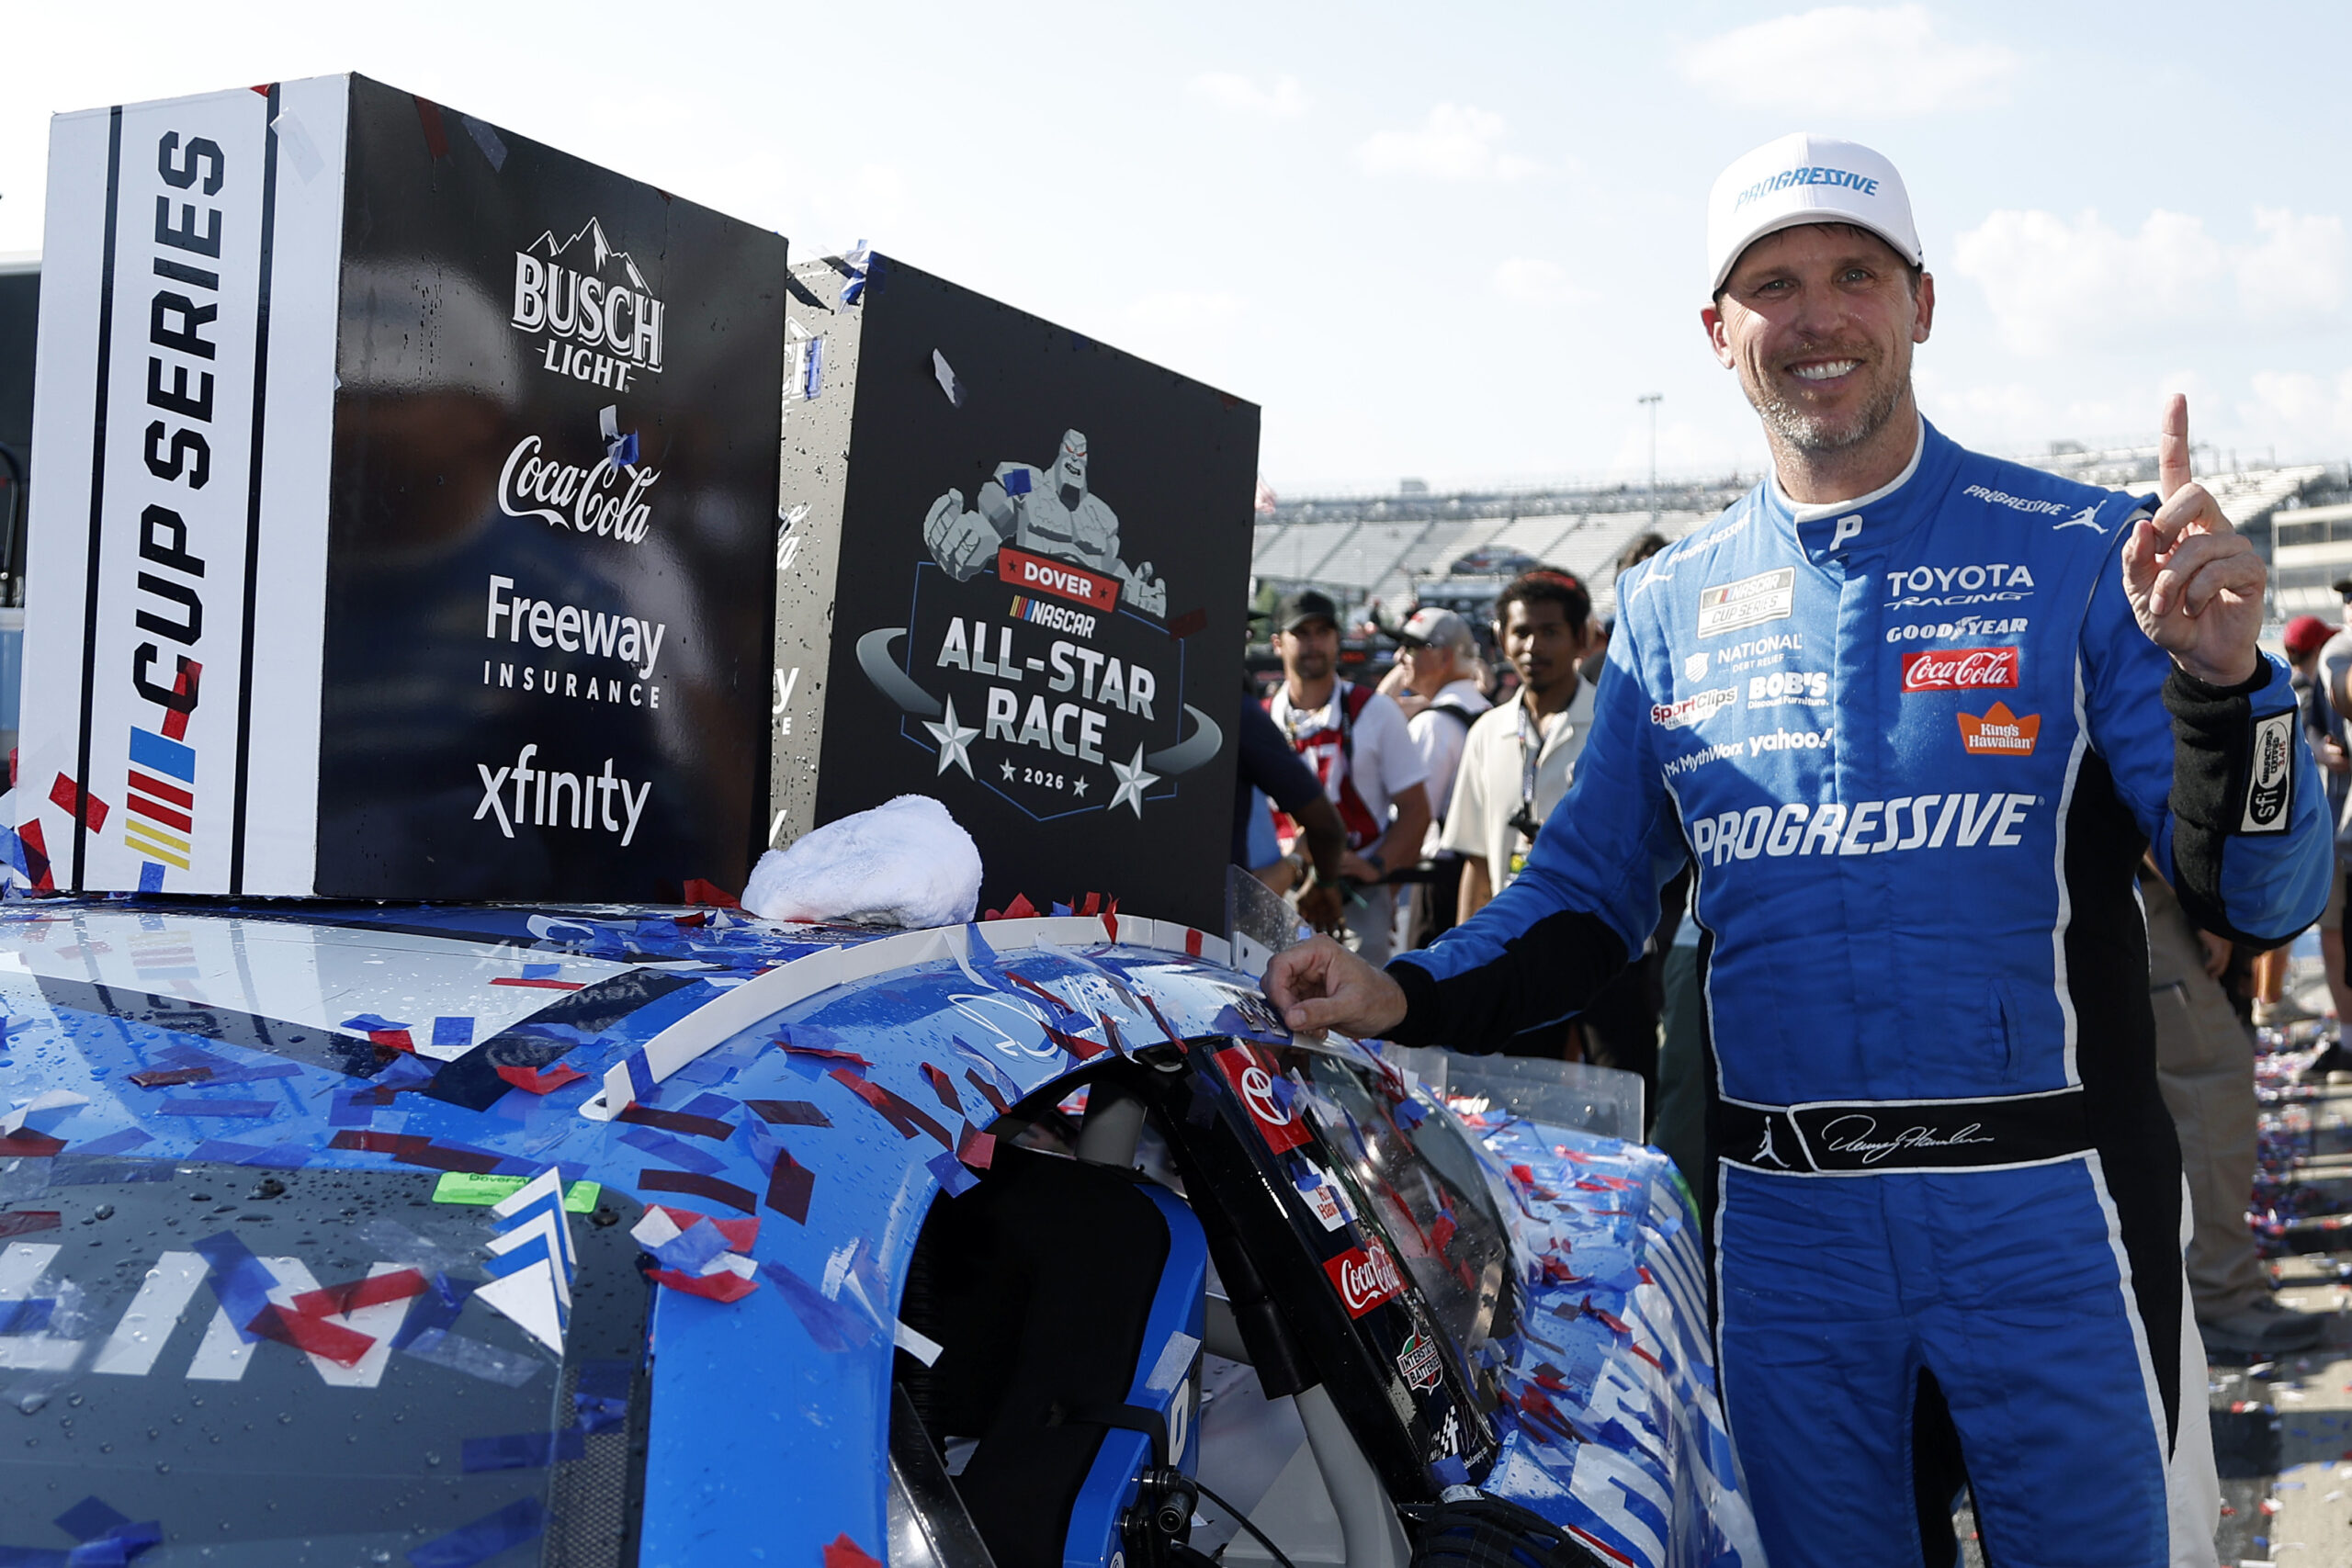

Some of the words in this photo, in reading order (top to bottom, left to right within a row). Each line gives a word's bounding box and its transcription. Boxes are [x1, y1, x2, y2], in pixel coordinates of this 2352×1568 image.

[1735, 166, 1880, 213] PROGRESSIVE
[144, 130, 225, 492] SERIES
[510, 252, 664, 374] BUSCH
[544, 339, 632, 392] LIGHT
[497, 434, 661, 544] Coca-Cola
[1963, 485, 2066, 516] PROGRESSIVE
[1023, 561, 1093, 599] DOVER
[1731, 574, 1781, 599] NASCAR
[1887, 564, 2035, 597] TOYOTA
[133, 506, 205, 714] CUP
[1712, 605, 1737, 624] CUP
[1883, 591, 2034, 610] RACING
[486, 574, 666, 680] Freeway
[1030, 599, 1096, 638] NASCAR
[1717, 634, 1803, 664] NATIONAL
[1732, 660, 1756, 673] DEBT
[1757, 653, 1785, 668] RELIEF
[483, 660, 661, 709] INSURANCE
[935, 616, 1156, 721] ALL-STAR
[1905, 651, 2013, 688] Coca-Cola
[1748, 671, 1828, 700] BOB'S
[984, 686, 1107, 765] RACE
[1749, 727, 1834, 757] yahoo!
[1981, 723, 2019, 737] King's
[1679, 741, 1744, 773] MythWorx
[1969, 735, 2031, 750] Hawaiian
[473, 744, 652, 847] xfinity
[1023, 768, 1064, 790] 2026
[2256, 789, 2278, 818] sfi
[1693, 793, 2037, 869] PROGRESSIVE
[1400, 1339, 1436, 1371] INTERSTATE
[1409, 1355, 1441, 1384] BATTERIES
